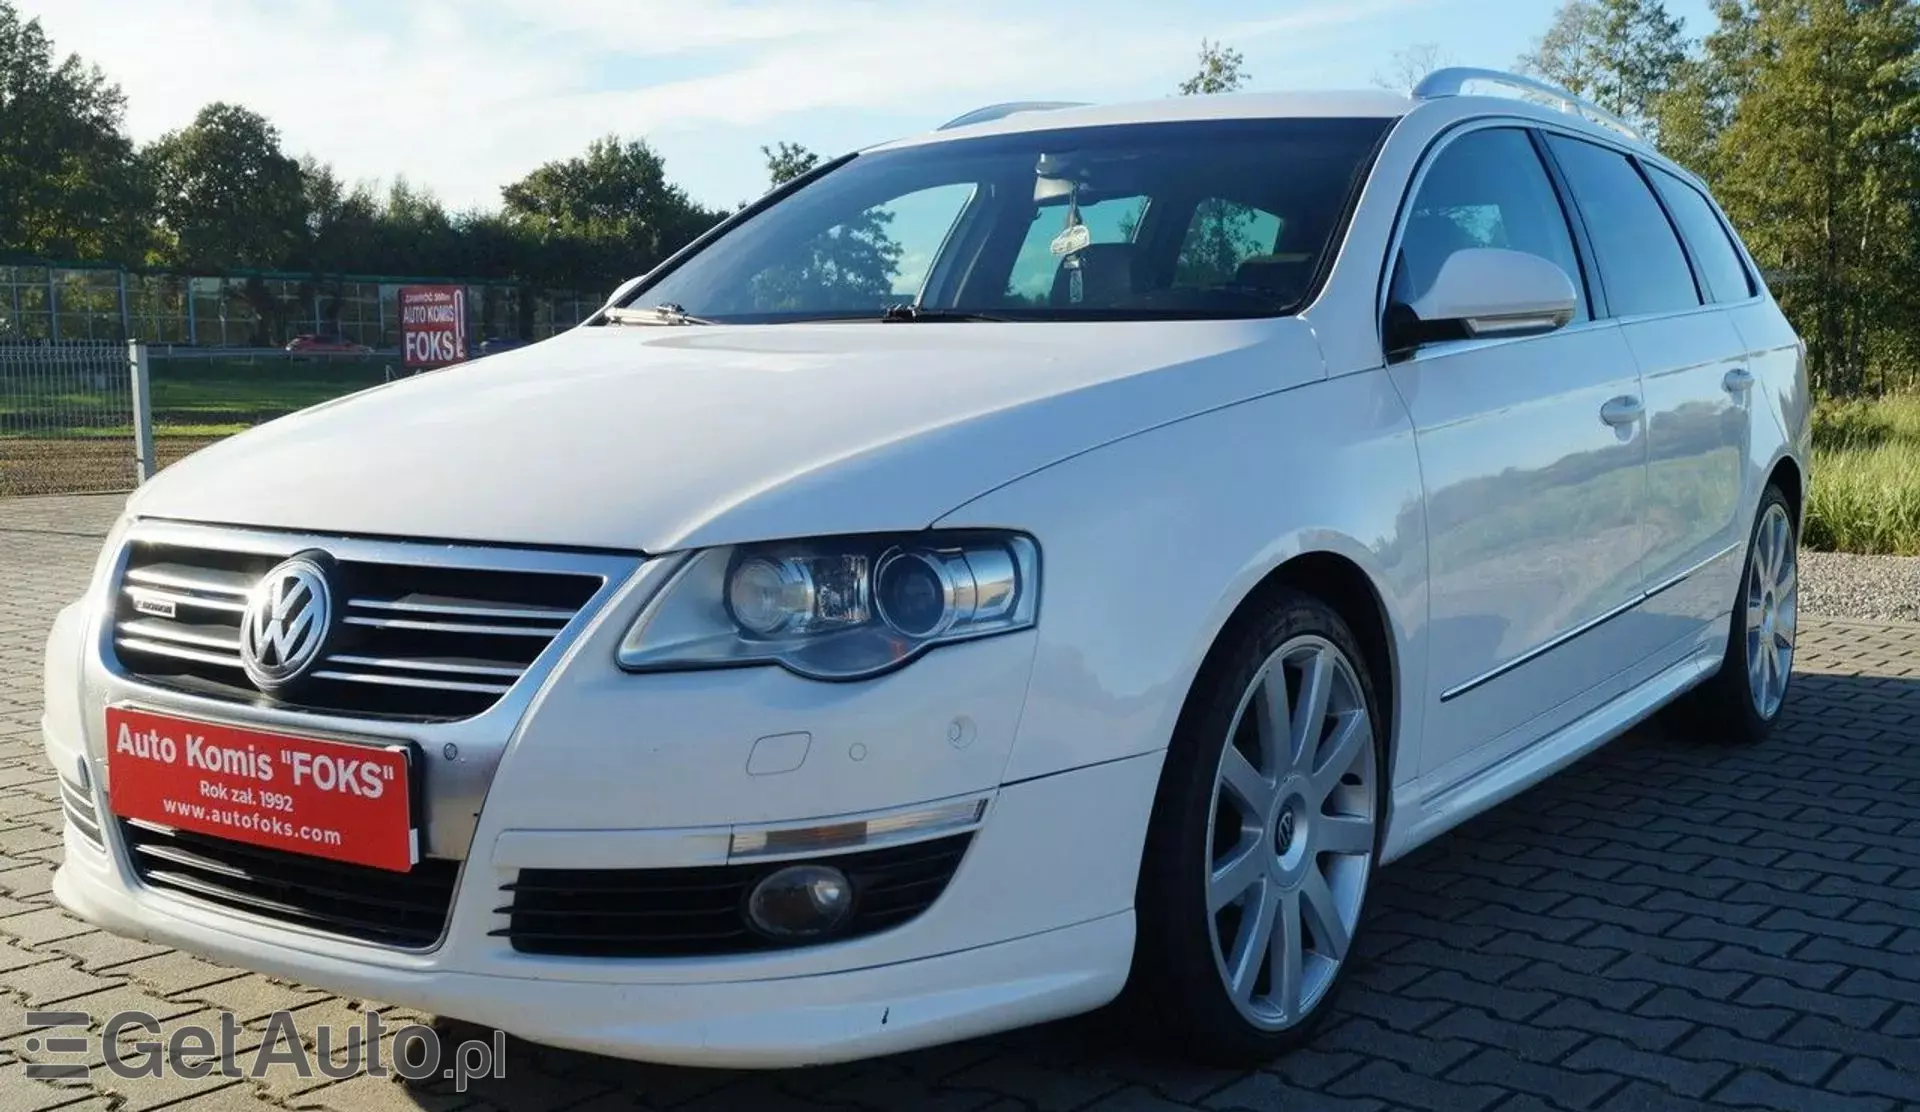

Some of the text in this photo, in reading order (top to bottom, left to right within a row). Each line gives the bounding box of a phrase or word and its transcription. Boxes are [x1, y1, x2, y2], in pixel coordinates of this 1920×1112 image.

[403, 304, 454, 324] AUTO KOMIS
[406, 331, 454, 361] FOKS
[116, 723, 394, 799] Auto Komis "FOKS"
[200, 780, 294, 812] Rok zał. 1992
[164, 799, 342, 845] www.autofoks.com
